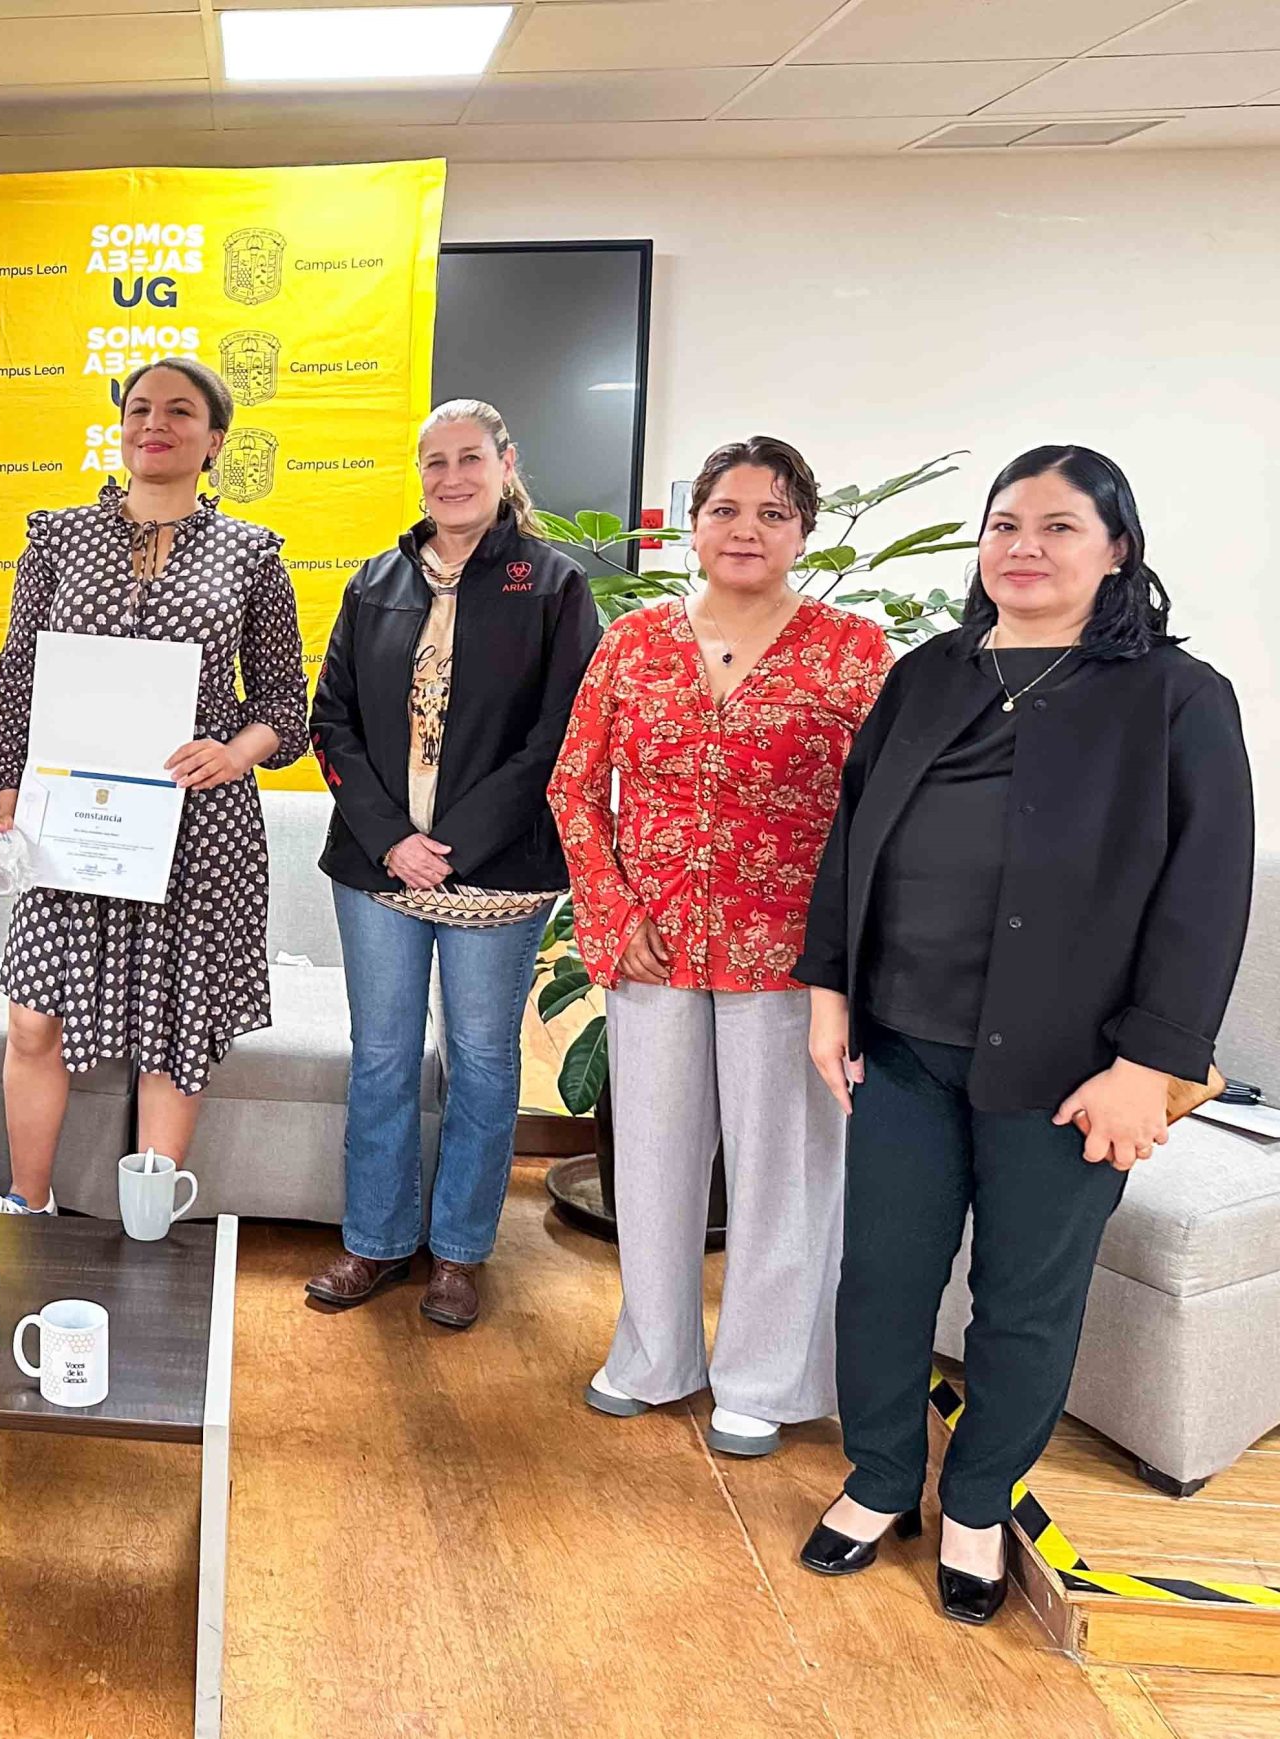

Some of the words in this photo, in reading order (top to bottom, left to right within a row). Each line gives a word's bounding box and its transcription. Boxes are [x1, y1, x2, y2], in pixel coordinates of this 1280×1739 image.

[90, 223, 205, 248] SOMOS
[36, 263, 67, 276] León
[294, 259, 348, 273] Campus
[113, 276, 177, 308] UG
[87, 325, 200, 350] SOMOS
[290, 361, 343, 375] Campus
[346, 359, 378, 371] León
[32, 460, 63, 472] León
[286, 458, 339, 472] Campus
[342, 457, 374, 469] León
[502, 583, 533, 592] ARIAT
[74, 811, 123, 823] constancia
[65, 1361, 85, 1369] Voces
